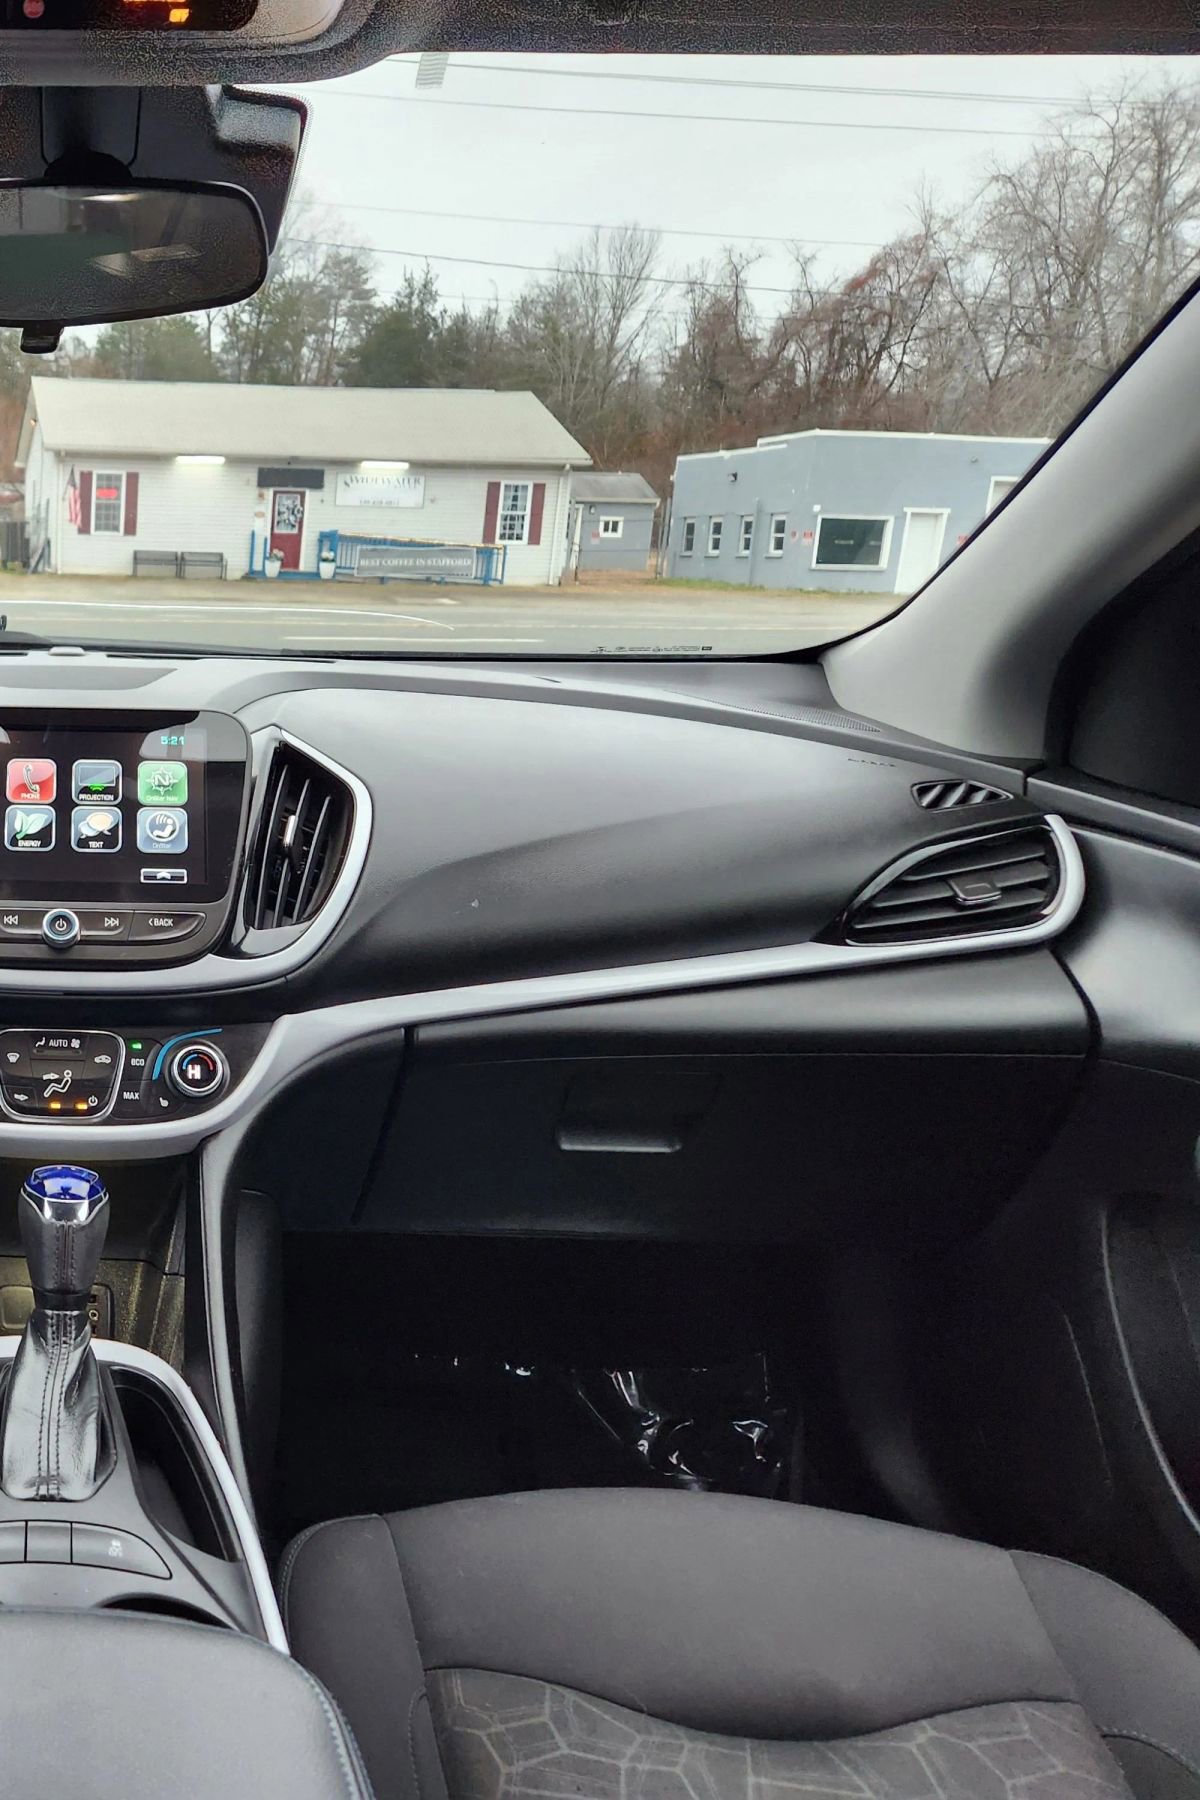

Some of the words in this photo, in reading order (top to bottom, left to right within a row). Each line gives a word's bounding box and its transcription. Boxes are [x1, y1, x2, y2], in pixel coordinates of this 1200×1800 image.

[382, 559, 415, 567] COFFEE
[160, 735, 185, 745] 5:21
[21, 792, 41, 800] PHONE
[79, 793, 115, 801] PROJECTION
[18, 839, 42, 848] ENERGY
[88, 841, 104, 849] TEXT
[153, 917, 174, 927] BACK
[49, 1038, 69, 1048] AUTO
[186, 1063, 202, 1080] HI
[122, 1091, 140, 1100] MAX
